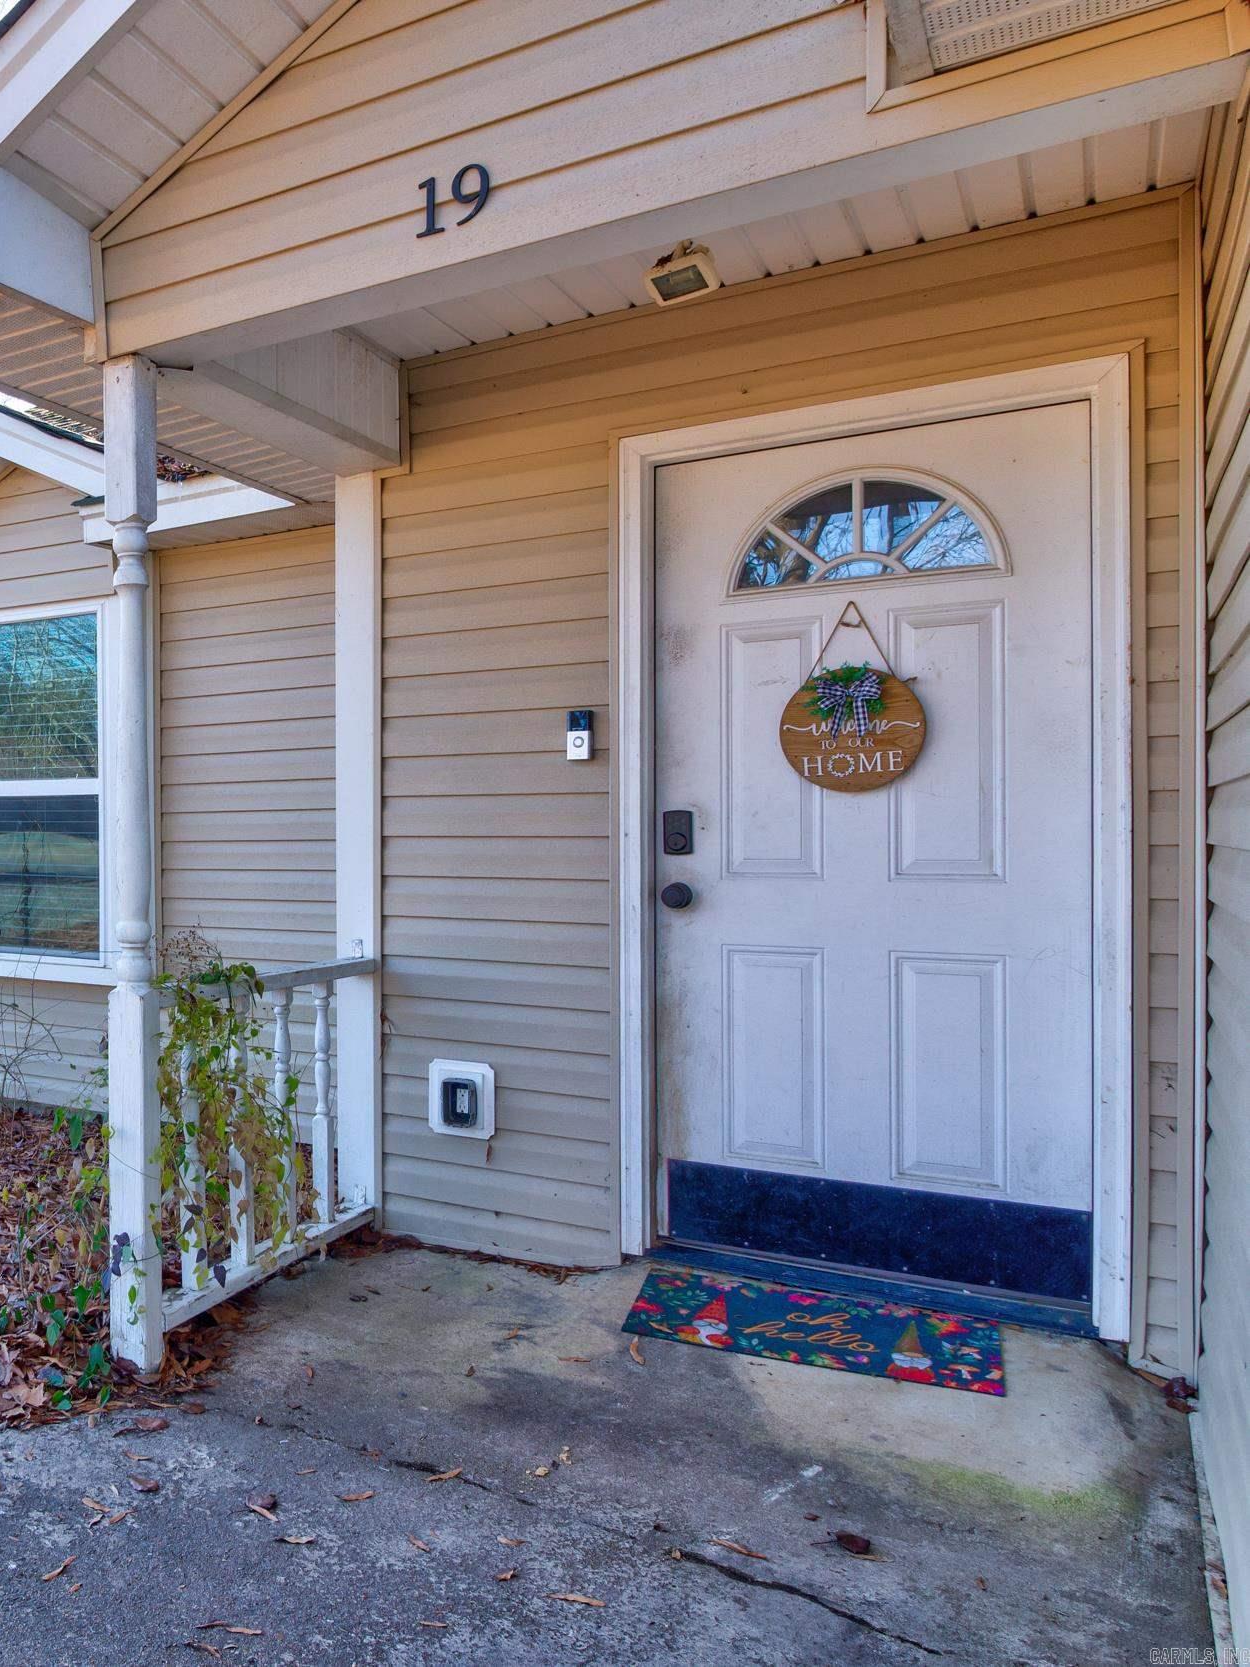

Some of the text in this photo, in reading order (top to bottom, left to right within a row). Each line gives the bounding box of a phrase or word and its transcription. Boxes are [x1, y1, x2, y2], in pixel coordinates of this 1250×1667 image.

[416, 164, 490, 239] 19
[819, 739, 837, 750] TO
[802, 750, 904, 777] HOME
[786, 1312, 852, 1328] oh
[735, 1321, 881, 1352] hello
